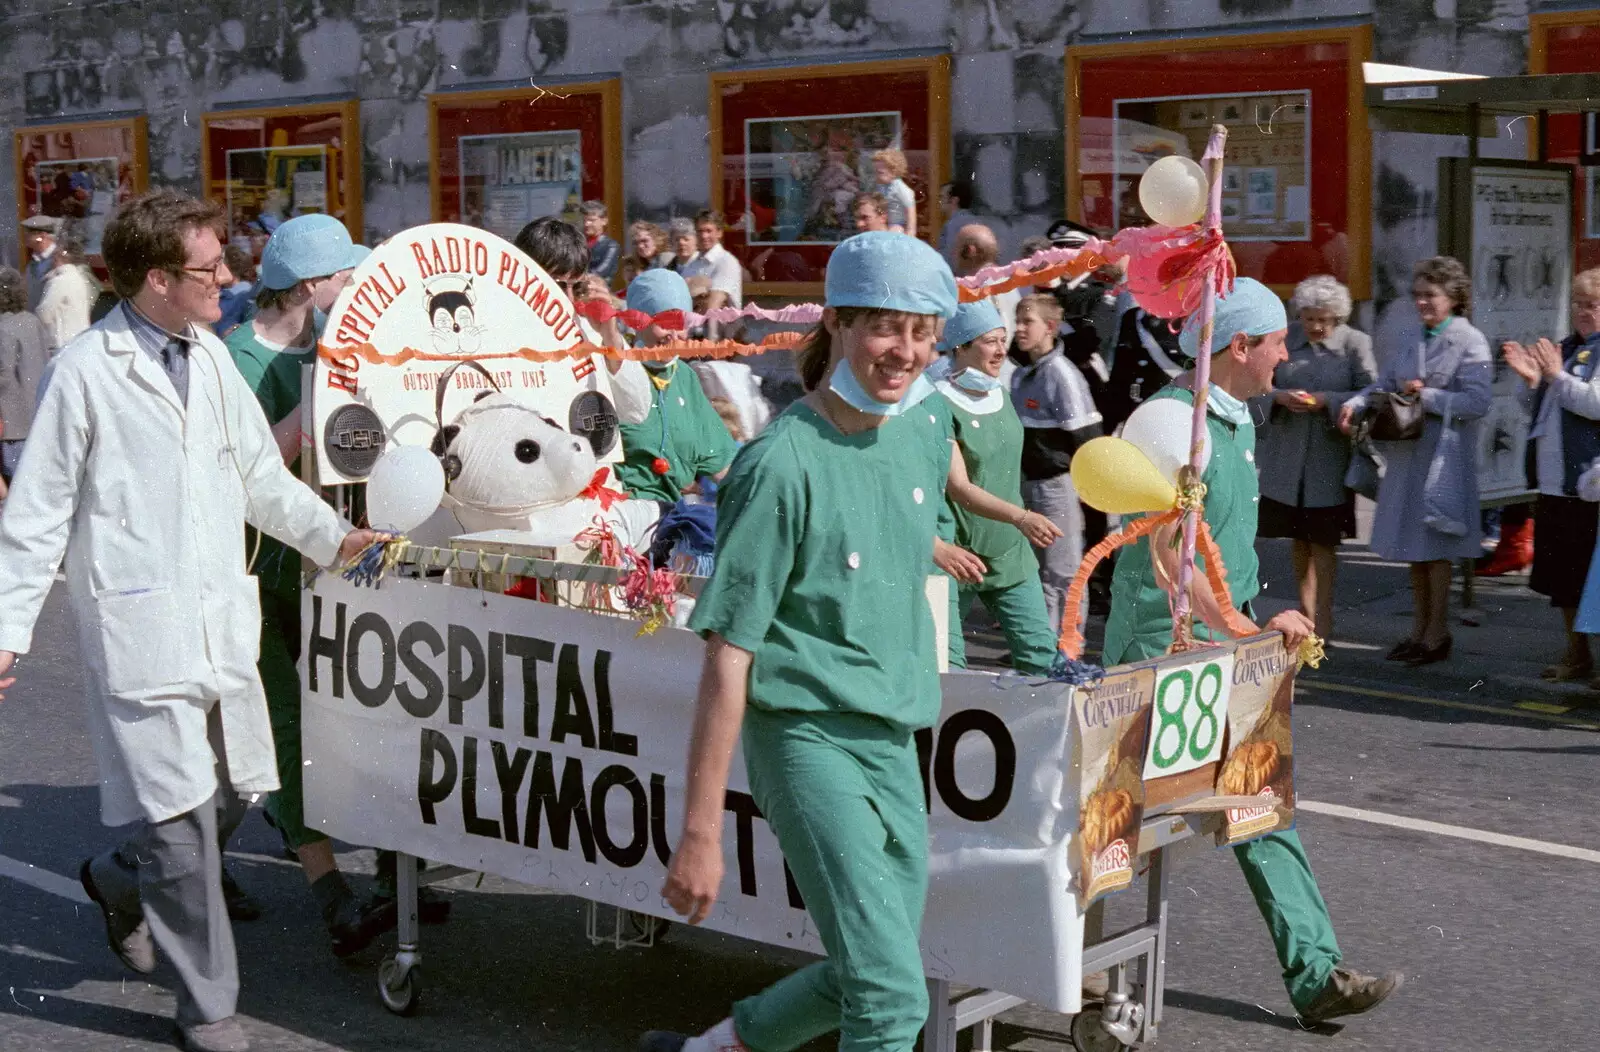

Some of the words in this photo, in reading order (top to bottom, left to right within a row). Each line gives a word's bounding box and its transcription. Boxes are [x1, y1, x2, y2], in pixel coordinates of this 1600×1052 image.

[327, 262, 407, 396] HOSPITAL
[410, 236, 488, 279] RADIO
[403, 372, 445, 392] OUTSID
[522, 370, 546, 389] UNIT
[308, 595, 638, 757] HOSPITAL
[1152, 663, 1222, 769] 88
[417, 727, 806, 910] PLYMOUT
